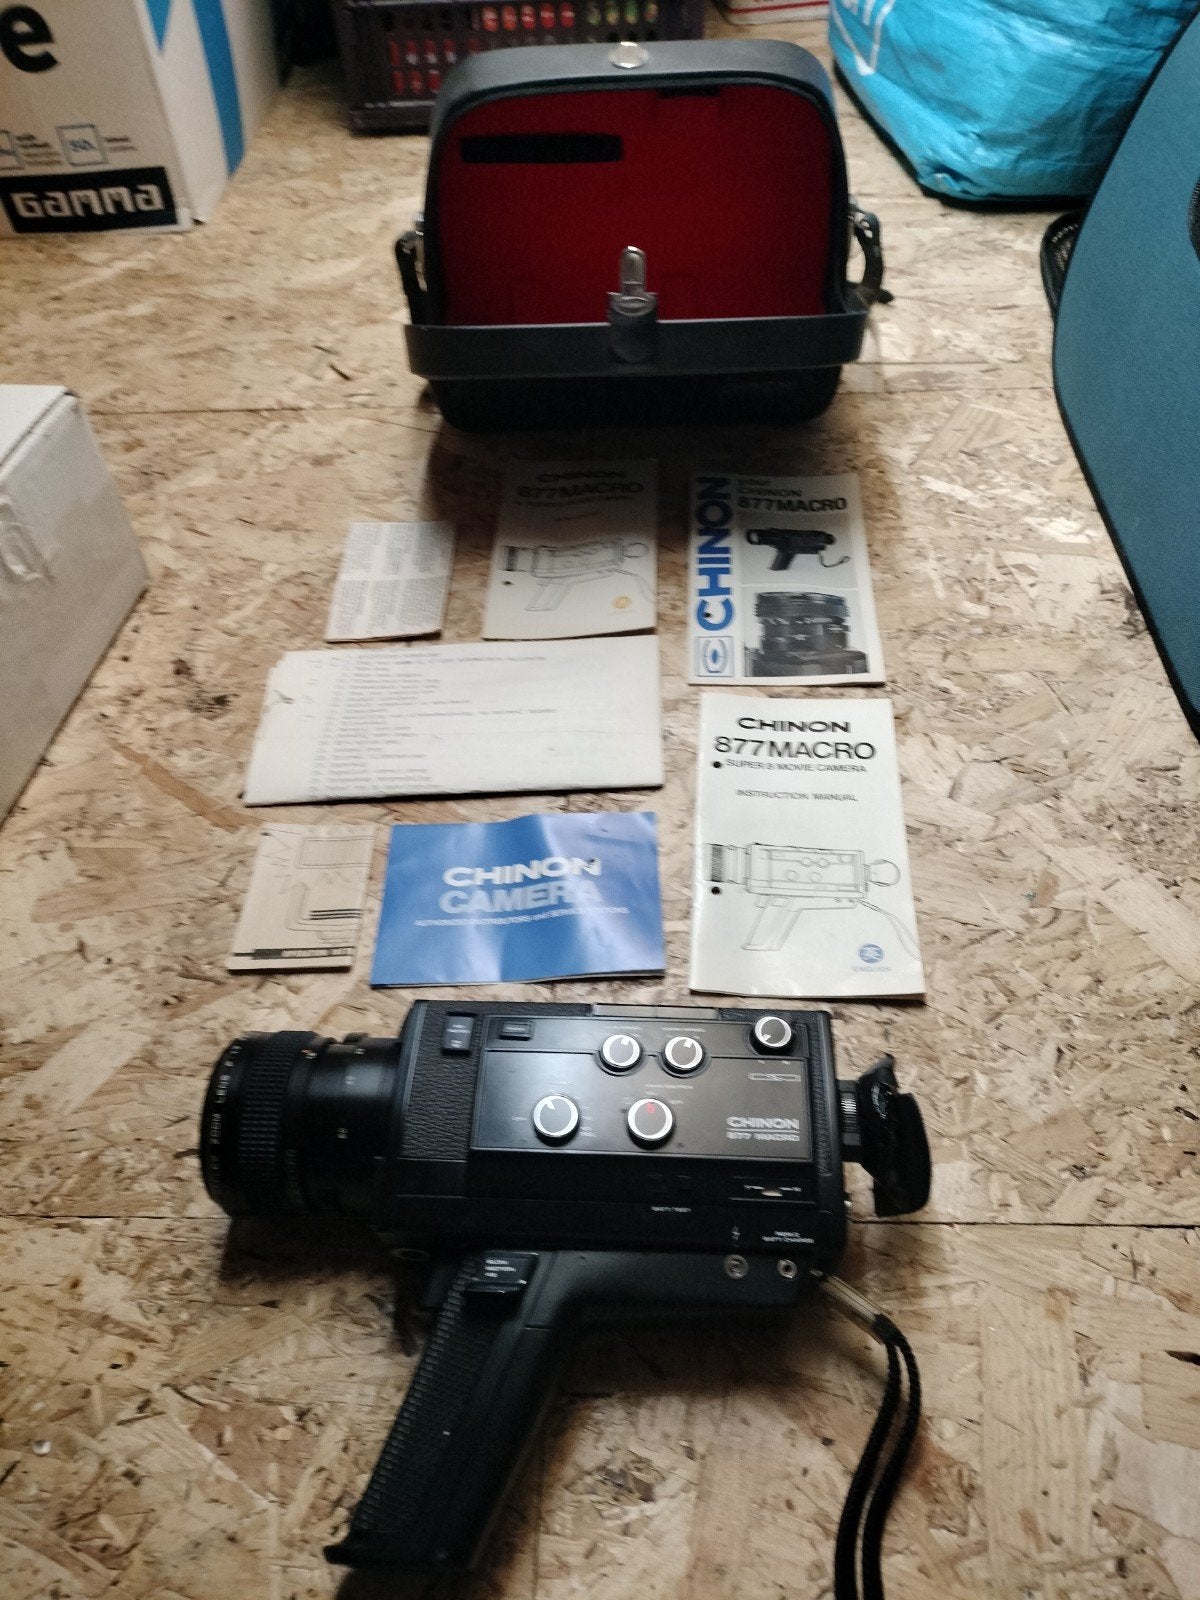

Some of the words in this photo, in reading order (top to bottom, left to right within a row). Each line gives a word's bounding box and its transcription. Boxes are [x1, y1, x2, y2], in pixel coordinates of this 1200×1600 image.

[696, 477, 734, 631] CHINON
[737, 717, 852, 733] CHINON
[714, 736, 877, 760] 877MACRO
[725, 758, 765, 770] SUPER
[777, 762, 814, 772] MOVIE
[816, 763, 868, 773] CAMERA
[736, 789, 809, 801] INSTRUCTION
[811, 791, 859, 802] MANUAL
[442, 856, 602, 887] CHINON
[438, 880, 602, 914] CAMERA
[726, 1116, 800, 1129] CHINON
